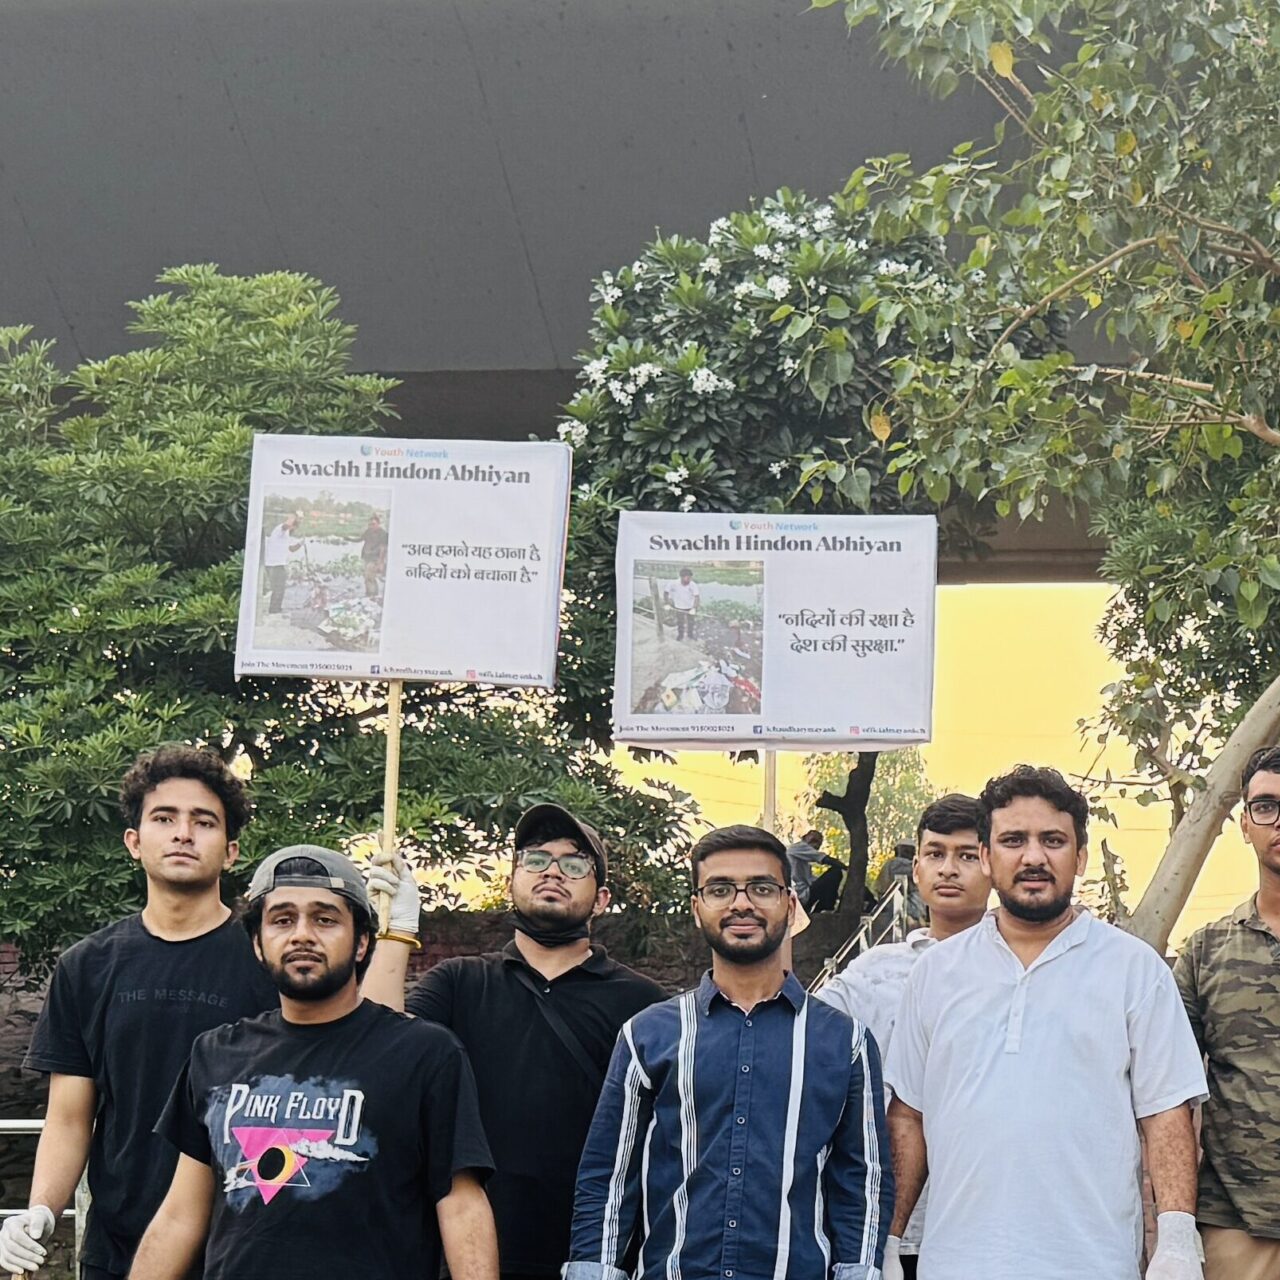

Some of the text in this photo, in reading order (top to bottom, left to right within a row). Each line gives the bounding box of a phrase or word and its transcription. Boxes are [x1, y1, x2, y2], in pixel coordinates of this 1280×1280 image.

[374, 446, 449, 459] Youth Network
[280, 459, 531, 486] Swachh Hindon Abhiyan
[743, 521, 819, 532] Youth Network
[649, 534, 902, 556] Swachh Hindon Abhiyan
[840, 608, 866, 627] की
[790, 632, 818, 654] देश
[821, 634, 848, 652] की
[118, 988, 228, 1008] THE MESSAGE
